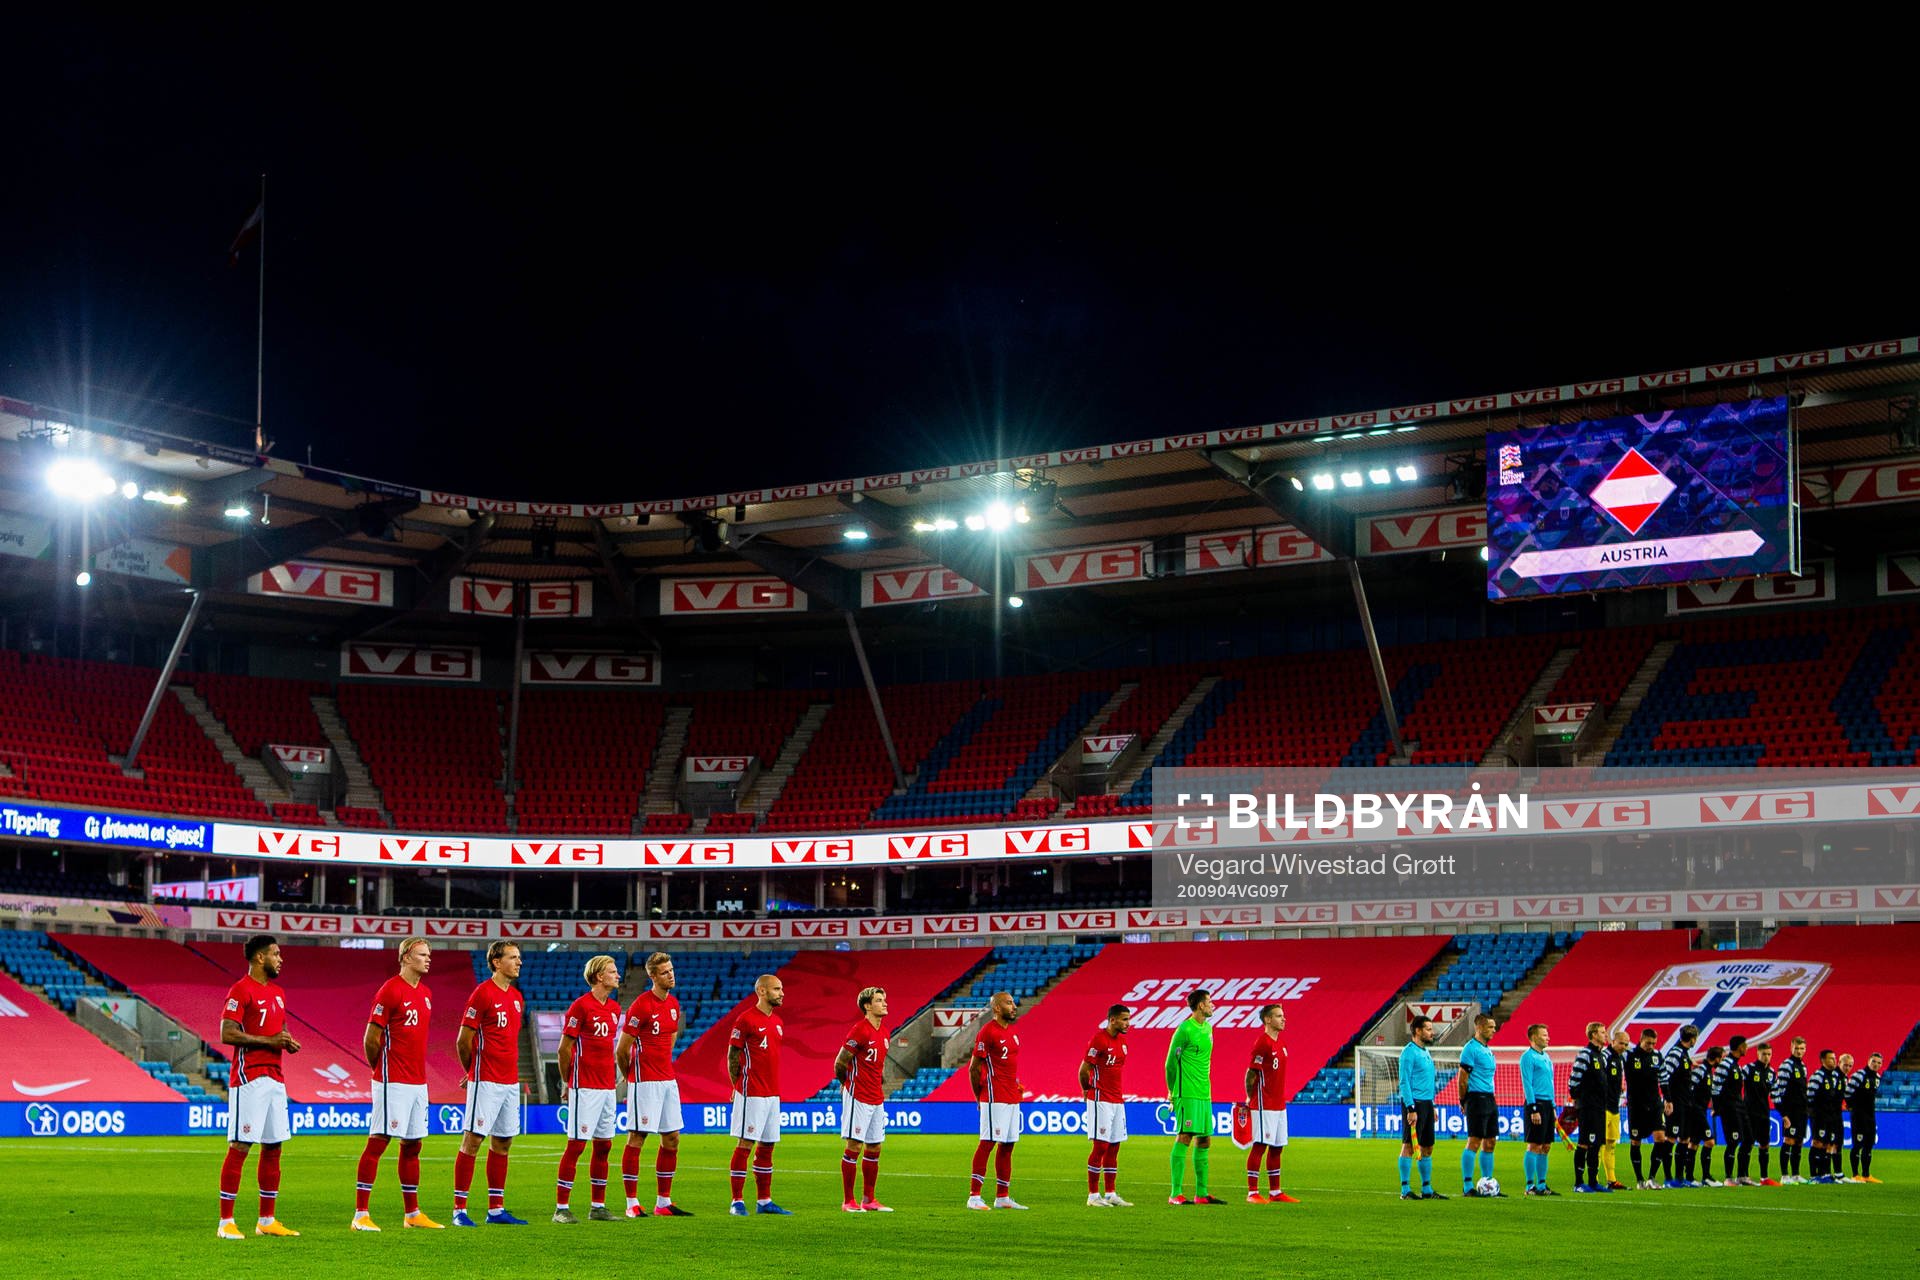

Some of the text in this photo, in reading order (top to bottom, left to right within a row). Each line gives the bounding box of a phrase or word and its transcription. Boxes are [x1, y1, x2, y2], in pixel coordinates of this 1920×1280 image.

[433, 343, 1897, 517] VG VG VG VG VG VG VG VG VG VG VG VG VG VG VG VG VG VG VG VG VG VG VG VG VG VG VG
[1374, 508, 1487, 549] VG
[1203, 531, 1314, 567] VG
[1600, 545, 1669, 564] AUSTRIA
[1030, 550, 1135, 584] VG
[269, 564, 374, 600] VG
[876, 569, 973, 600] VG
[467, 583, 573, 614] VG
[678, 581, 788, 609] VG
[354, 647, 466, 676] VG
[534, 654, 646, 680] VG
[275, 748, 322, 762] VG
[697, 759, 744, 771] VG
[3, 809, 60, 838] Tipping
[85, 816, 99, 839] Gi
[151, 826, 165, 843] en
[260, 832, 338, 857] VG
[381, 838, 468, 862] VG
[513, 843, 602, 865] VG
[645, 843, 733, 864] VG
[772, 839, 853, 862] VG
[889, 834, 968, 859] VG
[1006, 828, 1089, 854] VG
[1130, 821, 1215, 848] VG
[1546, 801, 1649, 829] VG
[1702, 793, 1812, 822] VG
[1871, 788, 1920, 814] V
[219, 913, 266, 928] VG
[283, 916, 337, 931] VG
[355, 919, 409, 934] VG
[428, 920, 483, 935] VG
[503, 922, 559, 936] VG
[578, 923, 634, 937] VG
[652, 923, 707, 937] VG
[725, 922, 778, 936] VG
[793, 921, 845, 935] VG
[862, 919, 910, 934] VG
[926, 917, 976, 932] VG
[991, 914, 1043, 930] VG
[1059, 912, 1113, 928] VG
[1130, 910, 1185, 926] VG
[1202, 908, 1259, 925] VG
[1277, 905, 1335, 922] VG
[1354, 903, 1415, 920] VG
[1433, 901, 1496, 918] VG
[1515, 898, 1581, 915] VG
[1602, 895, 1668, 912] VG
[1689, 892, 1760, 911] VG
[1781, 890, 1853, 908] VG
[1716, 964, 1775, 974] NORGE
[259, 1009, 267, 1027] 7
[404, 1009, 418, 1026] 23
[496, 1011, 507, 1028] 15
[593, 1022, 609, 1037] 20
[651, 1021, 660, 1035] 3
[759, 1035, 768, 1050] 4
[1001, 1046, 1008, 1059] 2
[864, 1048, 878, 1062] 21
[1272, 1057, 1279, 1070] 8
[63, 1111, 125, 1133] OBOS
[189, 1105, 213, 1128] Bli
[292, 1106, 315, 1133] på
[318, 1106, 373, 1128] obos.n
[704, 1106, 727, 1128] Bli
[812, 1106, 836, 1133] på
